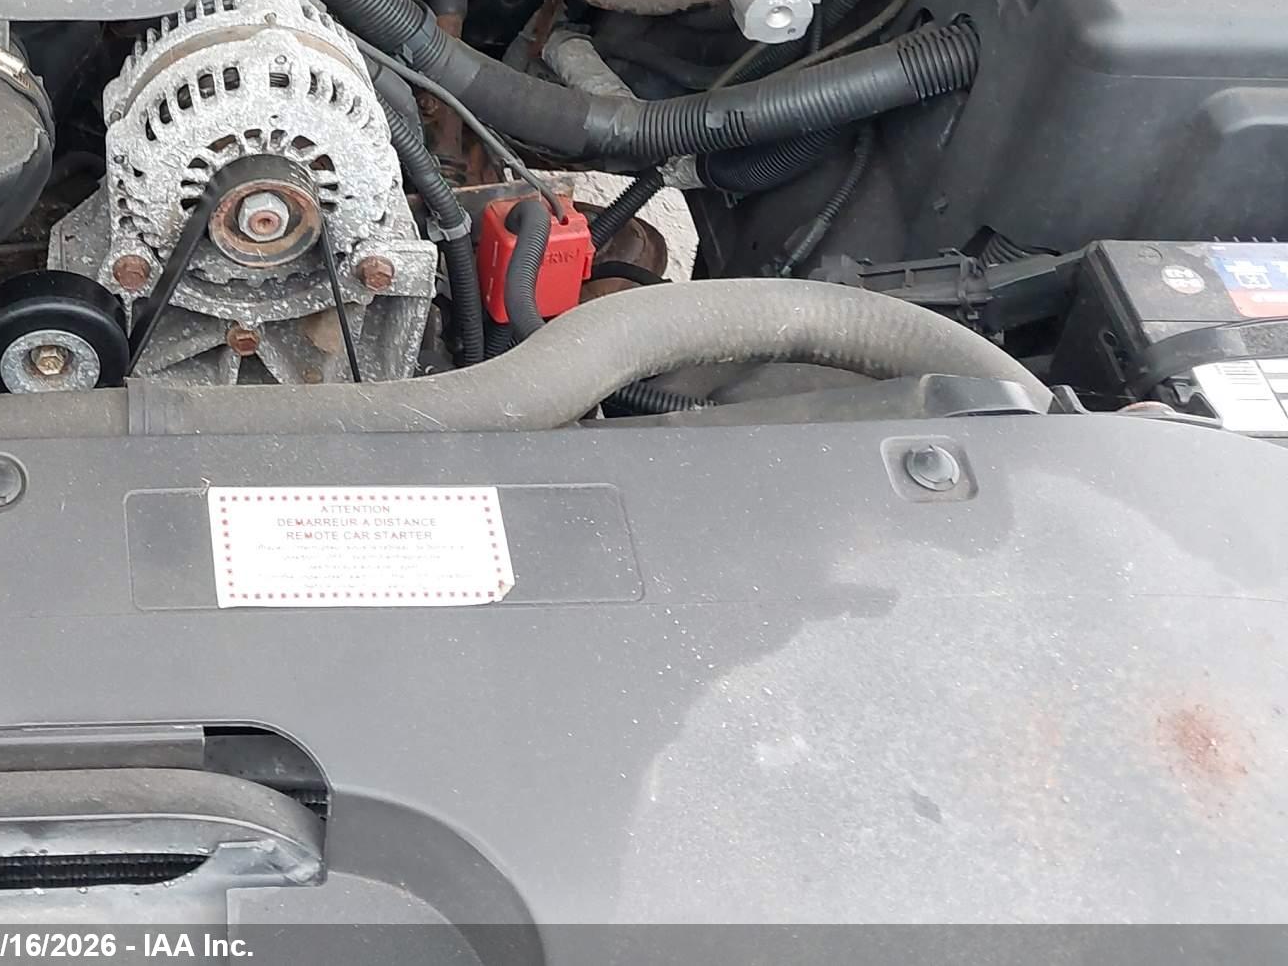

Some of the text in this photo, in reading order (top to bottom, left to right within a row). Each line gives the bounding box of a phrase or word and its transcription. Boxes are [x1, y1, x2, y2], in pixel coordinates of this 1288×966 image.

[320, 505, 391, 514] ATTENTION
[277, 518, 438, 527] DEMARREUR A DISTANCE
[286, 531, 433, 540] REMOTE CAR STARTER
